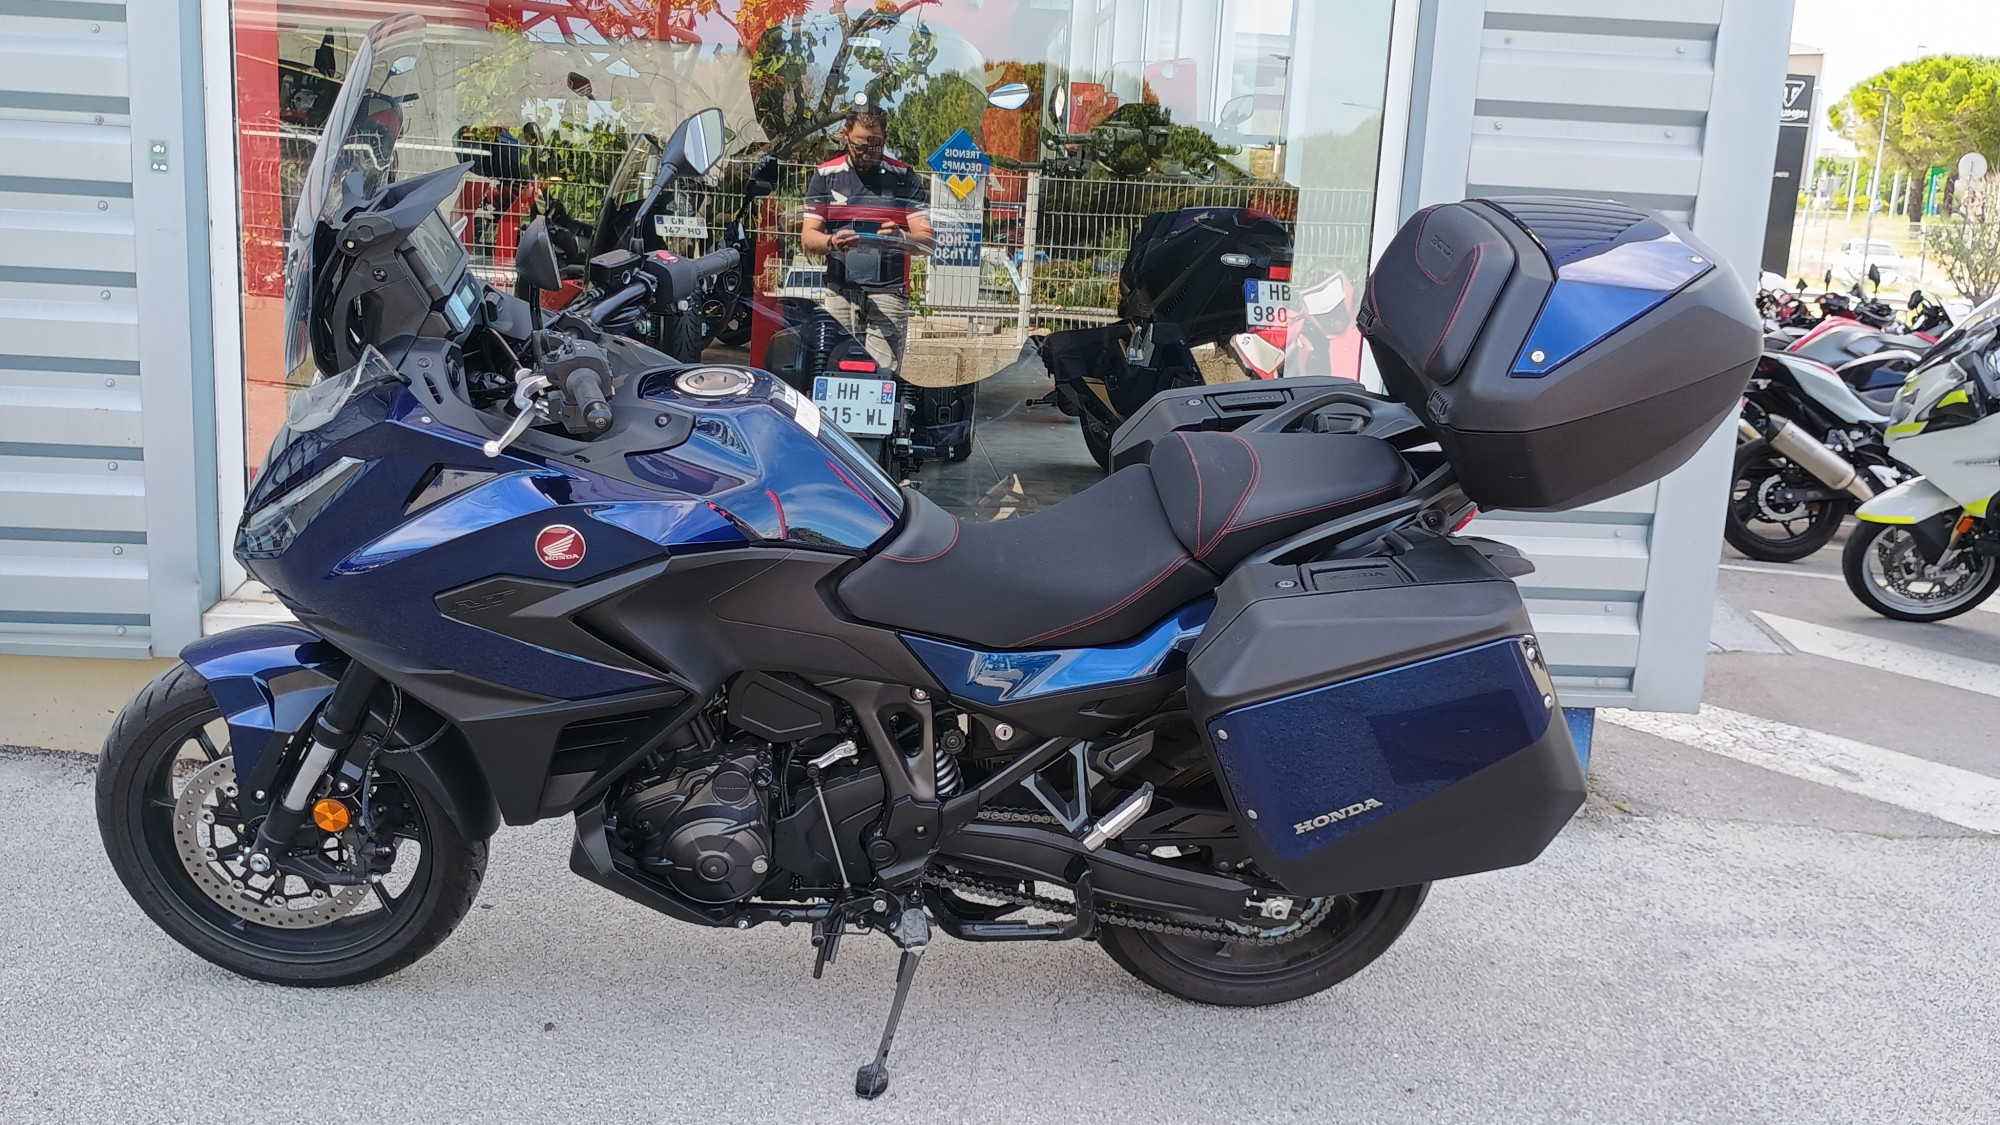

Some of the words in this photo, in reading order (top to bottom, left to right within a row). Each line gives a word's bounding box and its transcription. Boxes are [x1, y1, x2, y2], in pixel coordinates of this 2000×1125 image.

[1269, 284, 1291, 301] HB
[1253, 305, 1287, 323] 980
[837, 382, 860, 401] HH
[881, 393, 892, 404] 34
[544, 553, 580, 561] HONDA
[1293, 797, 1384, 835] HONDA
